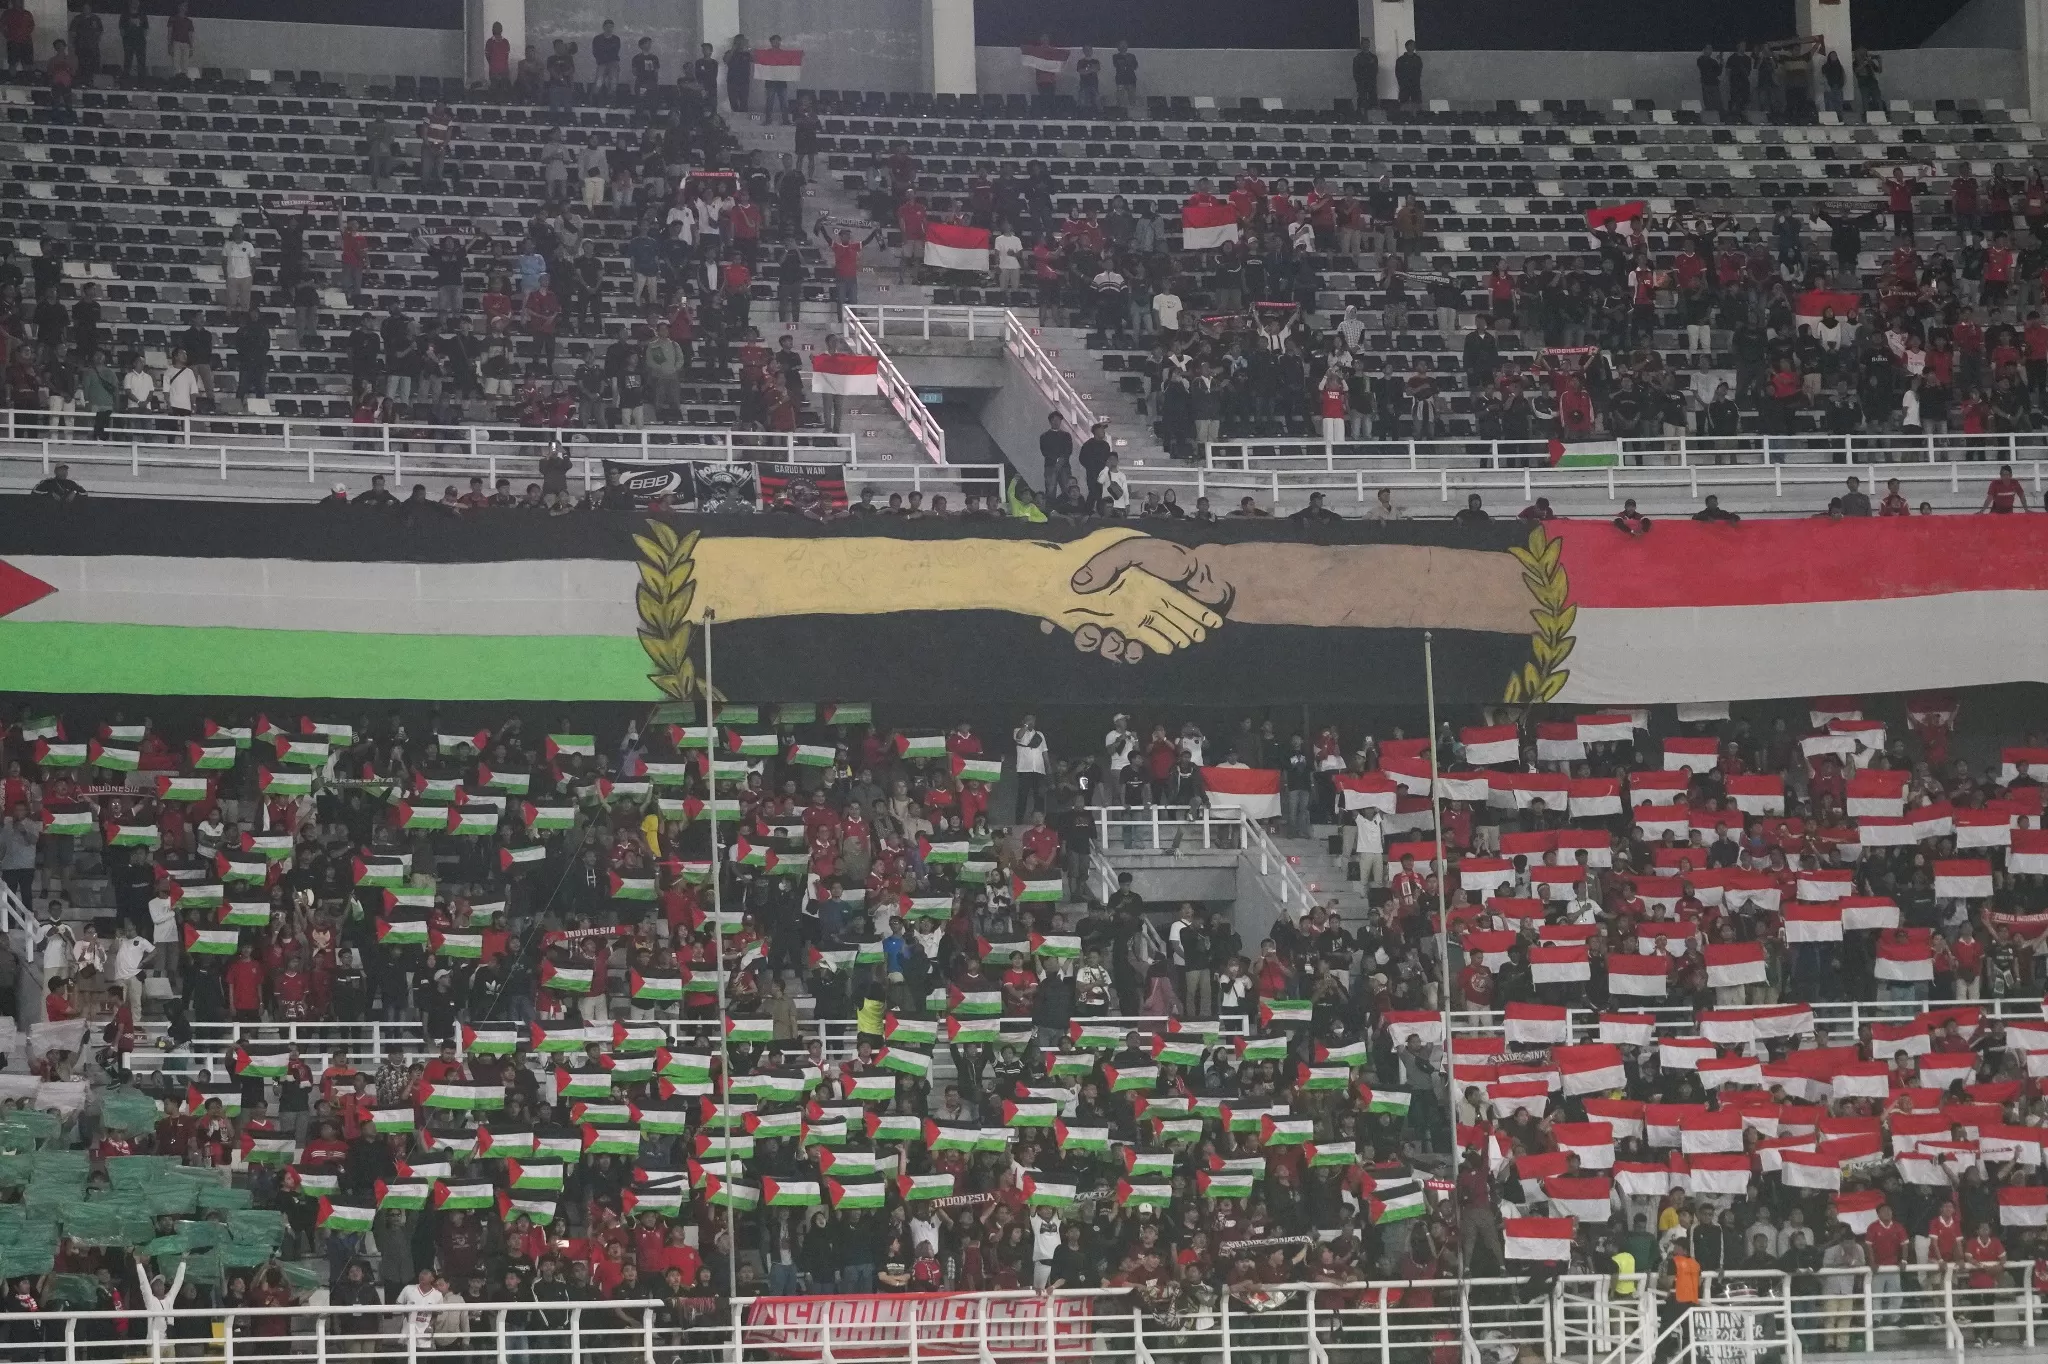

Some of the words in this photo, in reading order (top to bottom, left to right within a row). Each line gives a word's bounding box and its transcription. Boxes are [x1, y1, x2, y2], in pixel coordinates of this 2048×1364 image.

[1549, 347, 1589, 355] INDONESIA
[774, 465, 804, 474] GARUDA
[806, 466, 826, 475] WANI
[88, 785, 140, 793] INDONESIA
[563, 926, 616, 938] INDONESIA
[933, 1192, 995, 1208] INDONESIA
